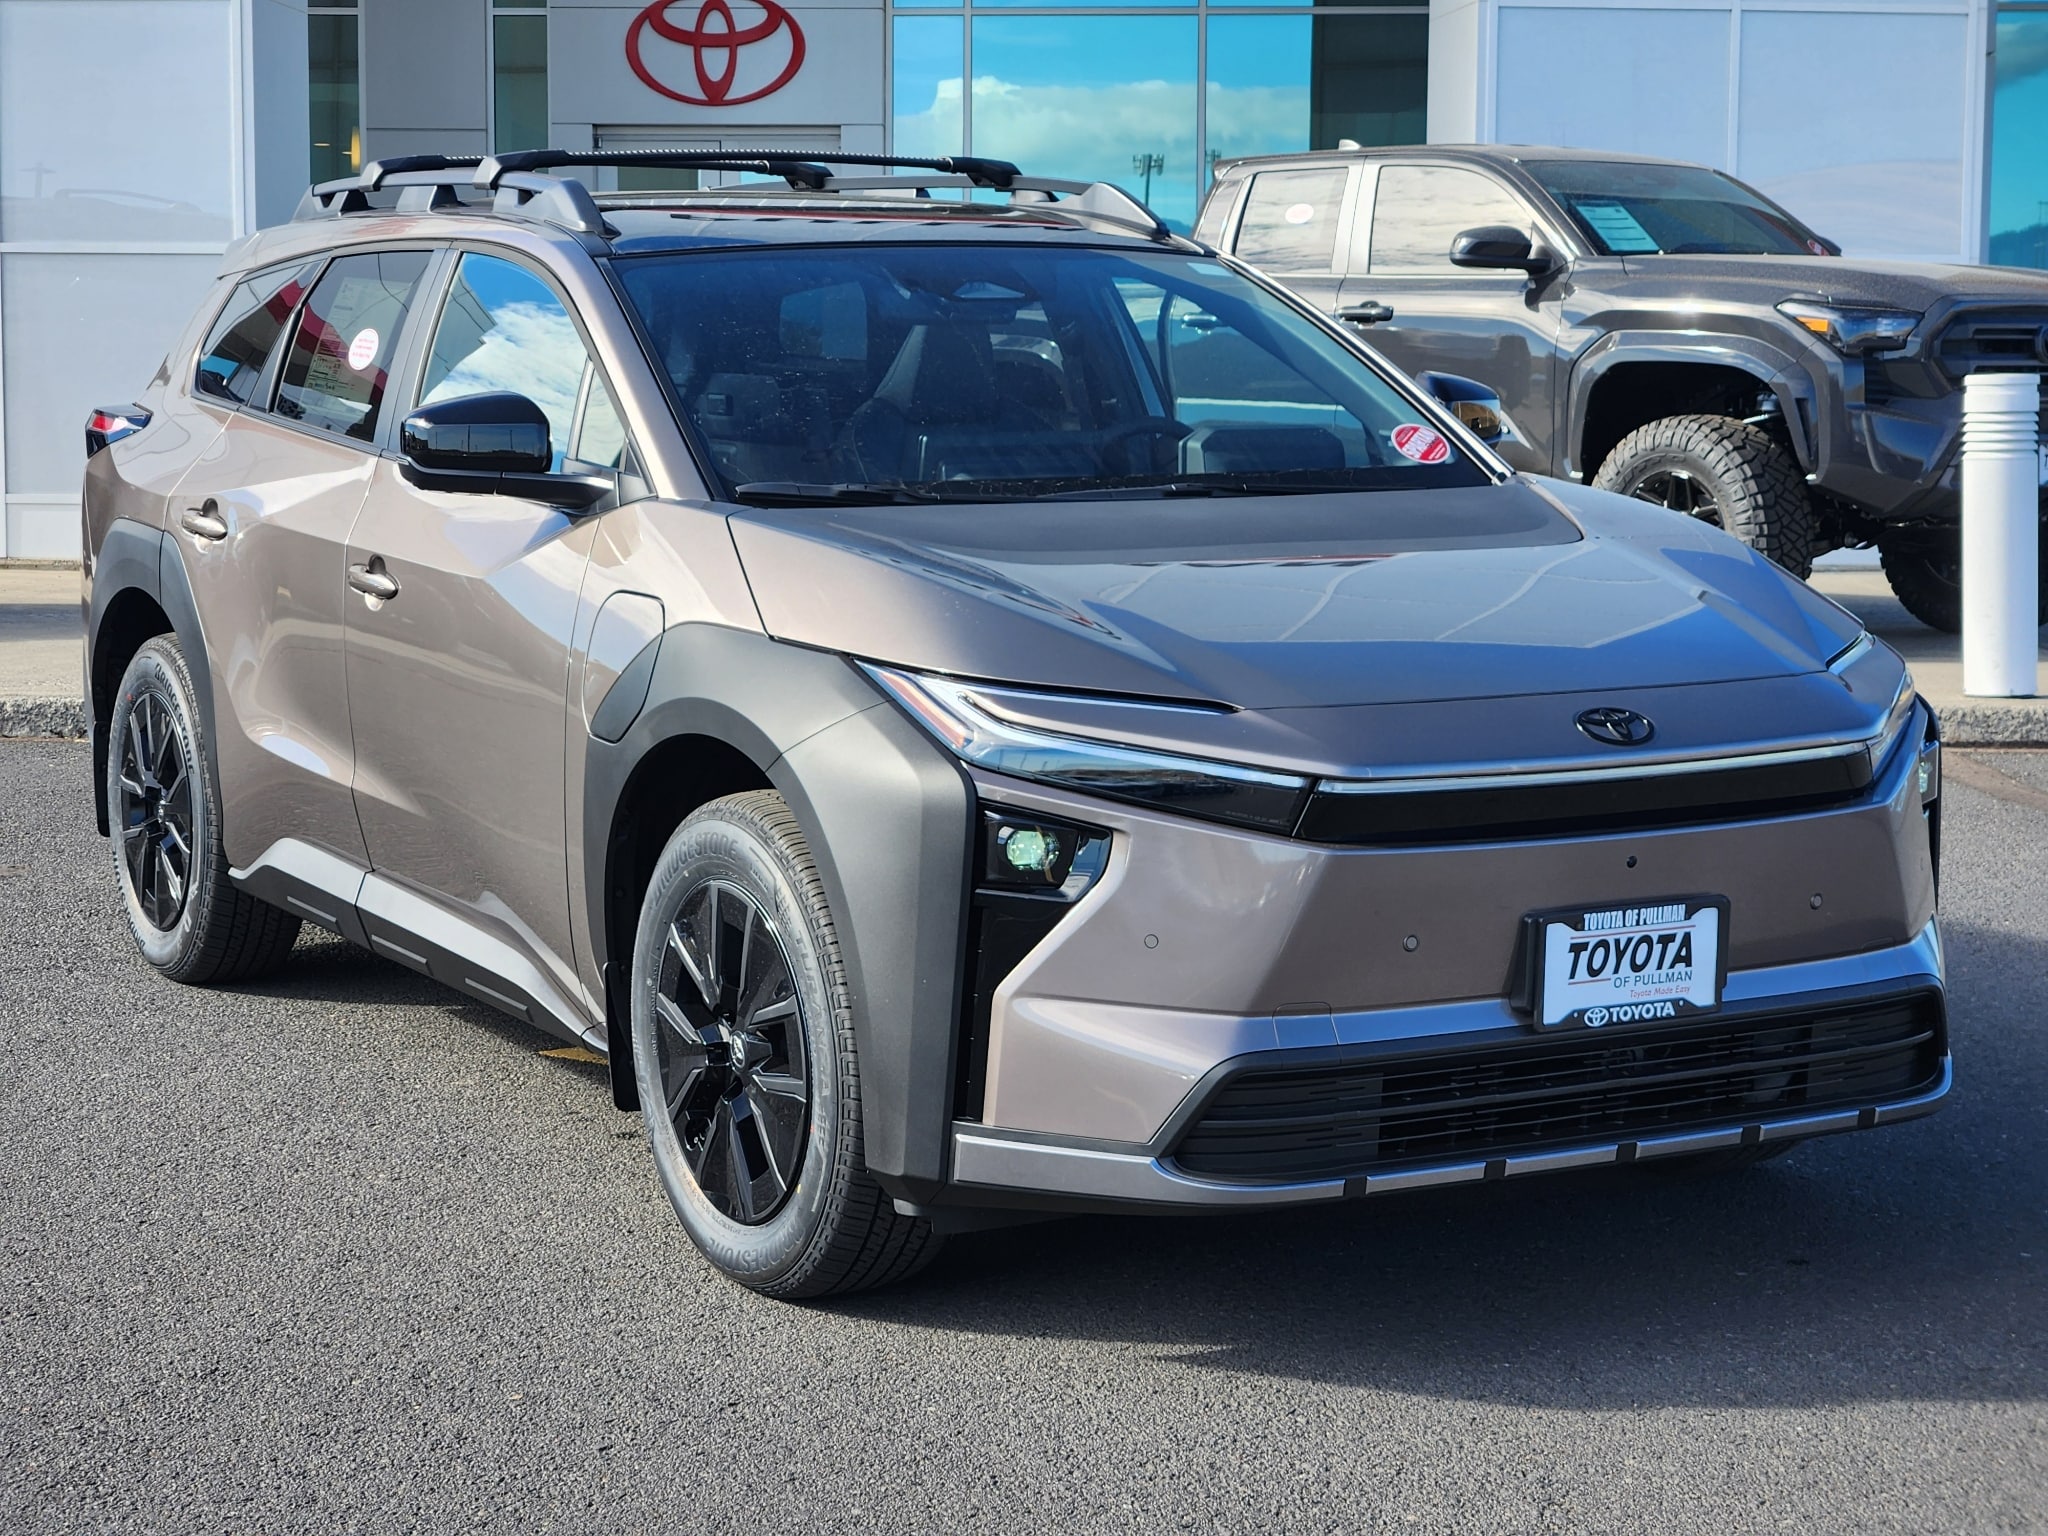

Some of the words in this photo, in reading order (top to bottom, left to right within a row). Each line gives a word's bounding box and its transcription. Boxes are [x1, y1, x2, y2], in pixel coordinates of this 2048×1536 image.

[1584, 910, 1623, 931] TOYOTA
[1625, 908, 1639, 927] OF
[1639, 904, 1686, 925] PULLMAN
[1567, 931, 1693, 980] TOYOTA
[1613, 976, 1630, 989] OF
[1634, 970, 1693, 987] PULLMAN
[1629, 988, 1652, 999] Toyota
[1653, 986, 1674, 996] Made
[1675, 984, 1691, 995] Easy
[1609, 1001, 1676, 1022] TOYOTA
